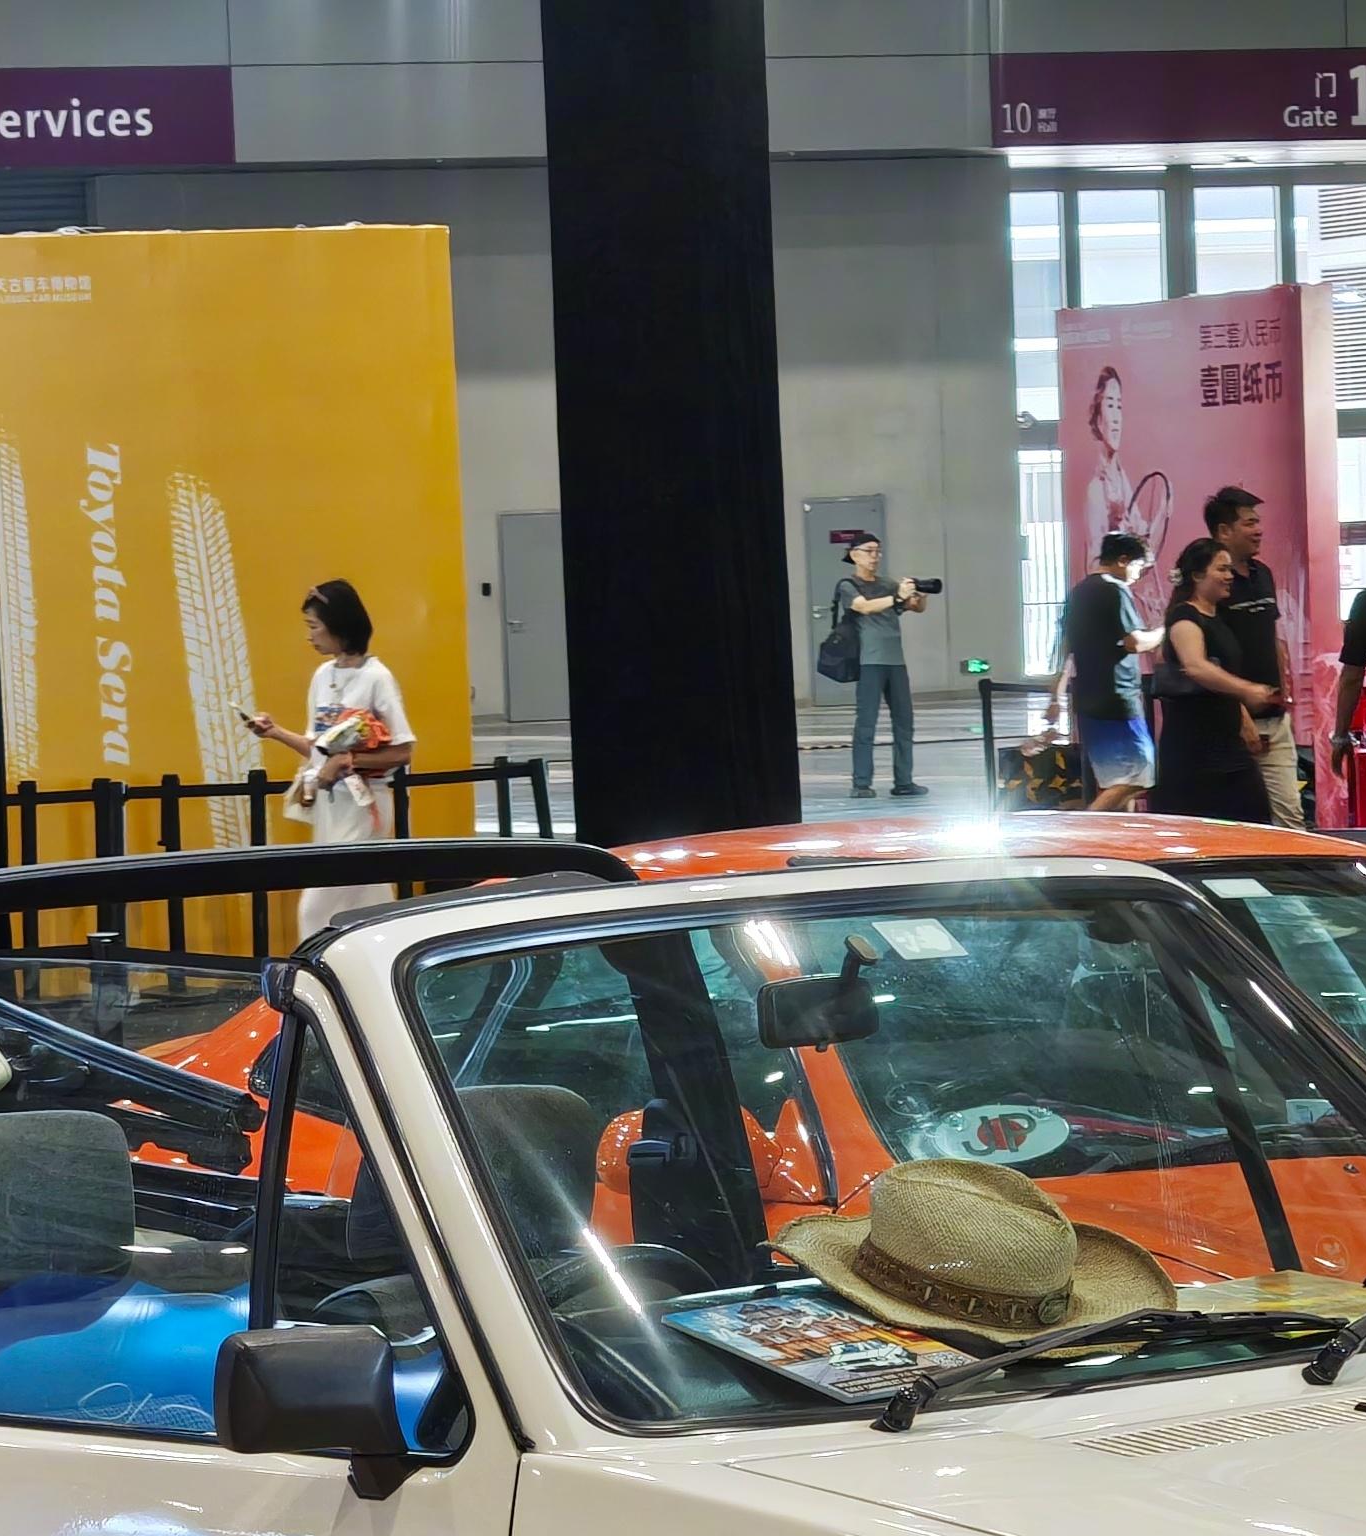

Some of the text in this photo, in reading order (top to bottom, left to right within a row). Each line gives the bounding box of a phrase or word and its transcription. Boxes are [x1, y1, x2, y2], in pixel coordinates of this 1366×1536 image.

[1314, 72, 1338, 98] 门
[1002, 102, 1032, 133] 10
[1283, 105, 1338, 128] Gate
[79, 443, 132, 766] Toyota Sera
[962, 1112, 1037, 1156] JP
